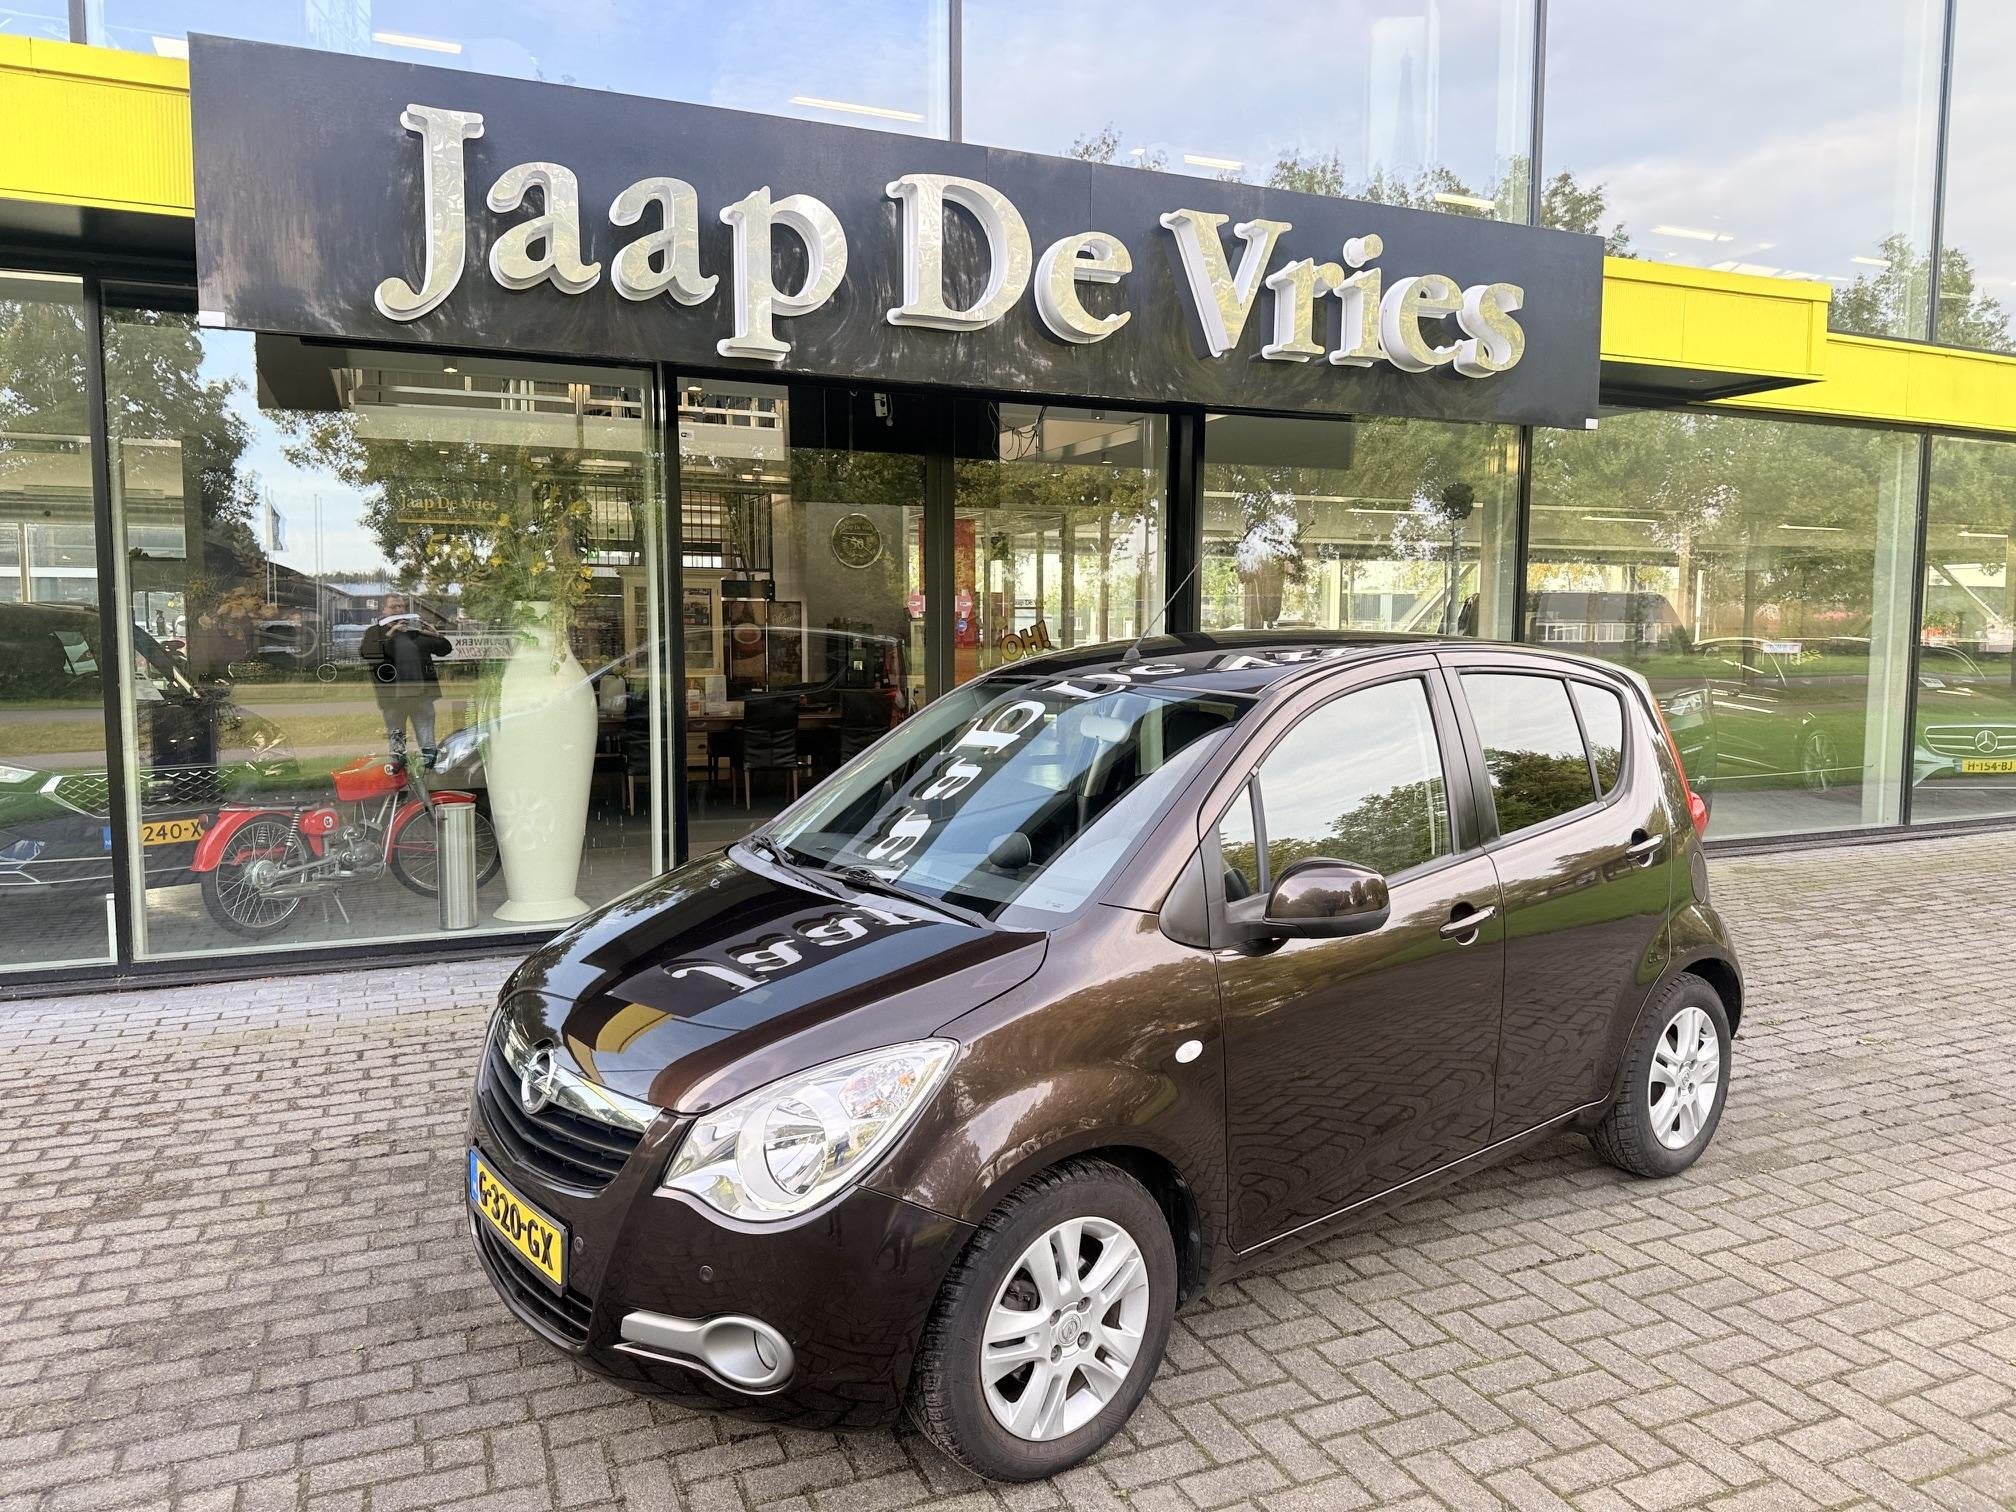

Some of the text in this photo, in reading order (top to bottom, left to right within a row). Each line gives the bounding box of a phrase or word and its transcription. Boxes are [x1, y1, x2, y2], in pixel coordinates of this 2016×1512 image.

[374, 103, 1525, 379] Jaap De Vries
[399, 493, 497, 512] Jaap De Vries
[1000, 619, 1051, 661] OH!
[1967, 761, 2013, 771] H-154-BJ
[479, 1170, 554, 1271] G-320-GX
